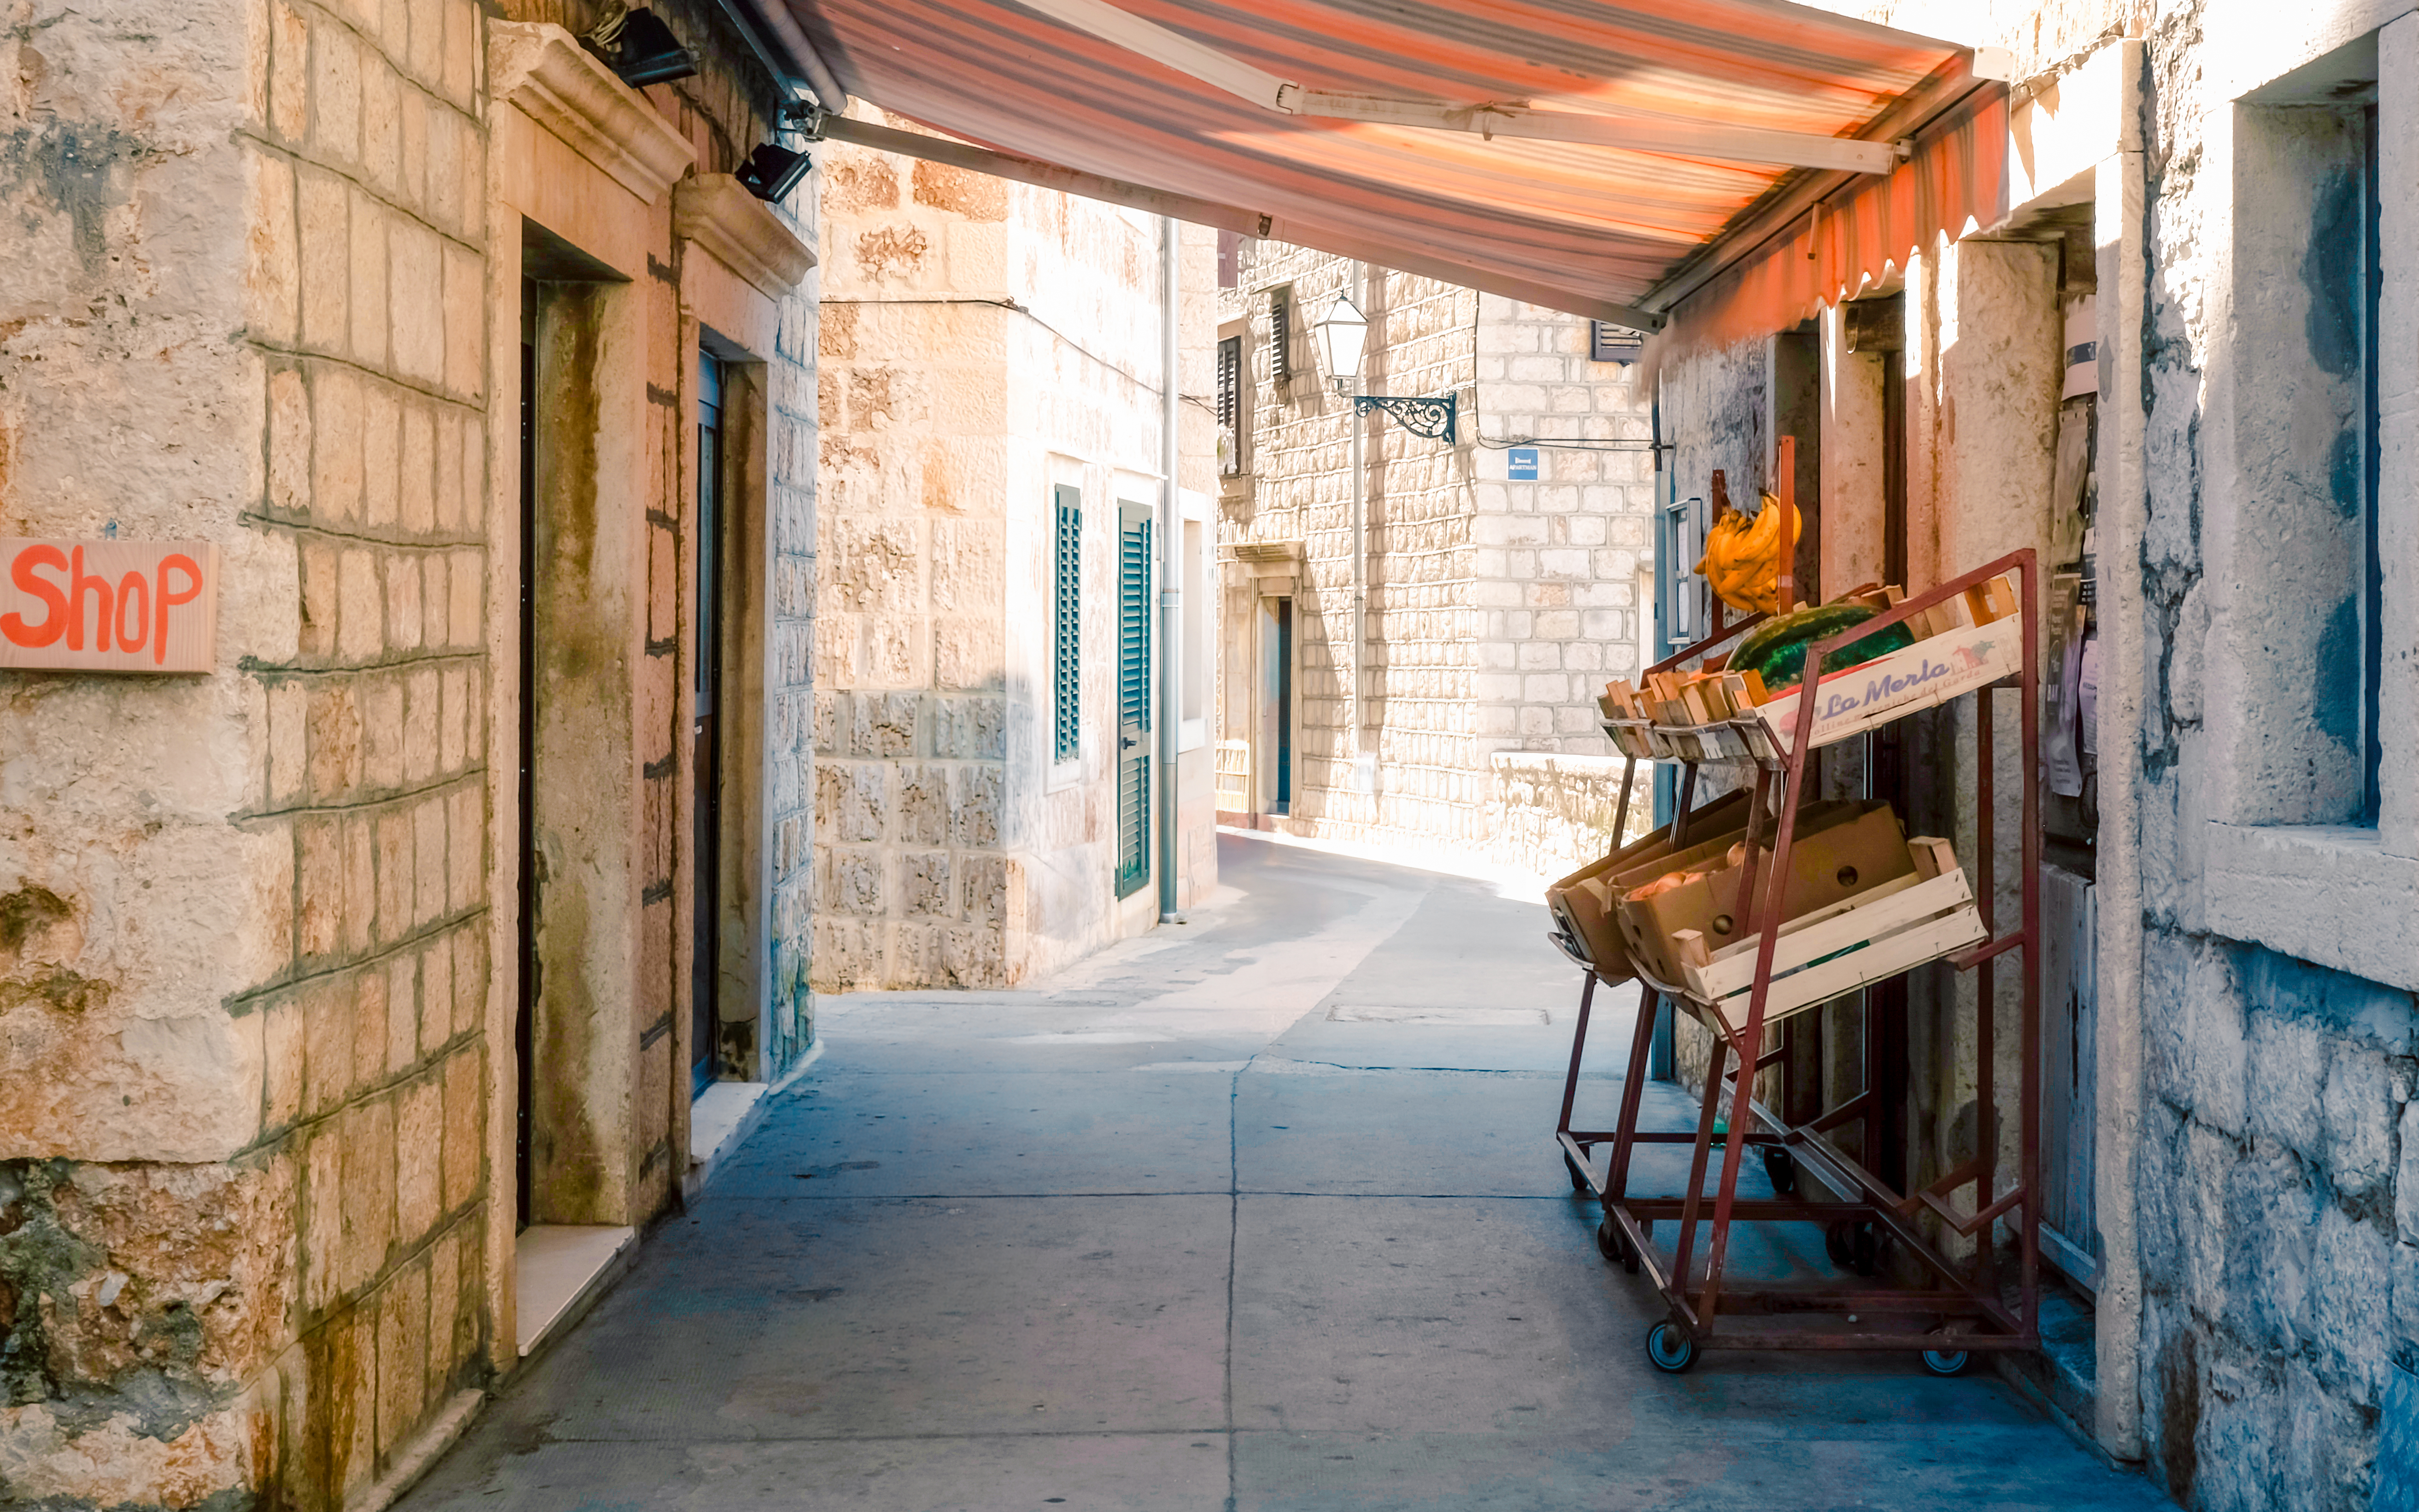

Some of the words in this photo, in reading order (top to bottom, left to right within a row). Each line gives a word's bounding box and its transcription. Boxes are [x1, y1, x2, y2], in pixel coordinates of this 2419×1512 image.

[1813, 717, 1850, 735] olline
[1920, 683, 1938, 696] del
[1943, 669, 1980, 688] Garda
[1820, 694, 1860, 721] La
[1862, 659, 1949, 708] Merla
